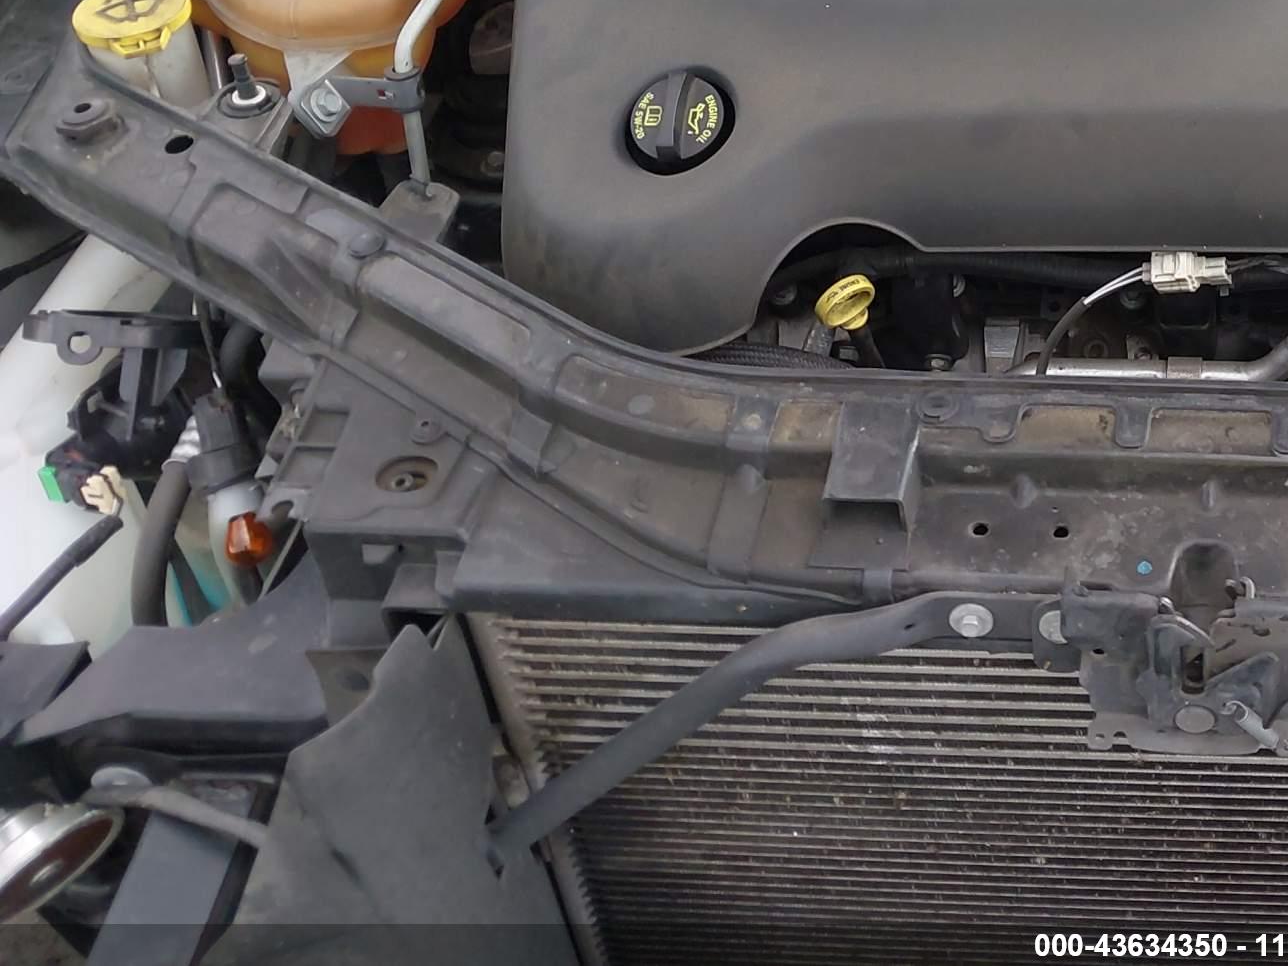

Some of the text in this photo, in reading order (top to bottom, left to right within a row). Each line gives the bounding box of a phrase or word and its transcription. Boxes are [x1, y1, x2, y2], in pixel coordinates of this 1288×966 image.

[638, 92, 655, 110] SAE
[695, 94, 718, 144] ENGINE OIL
